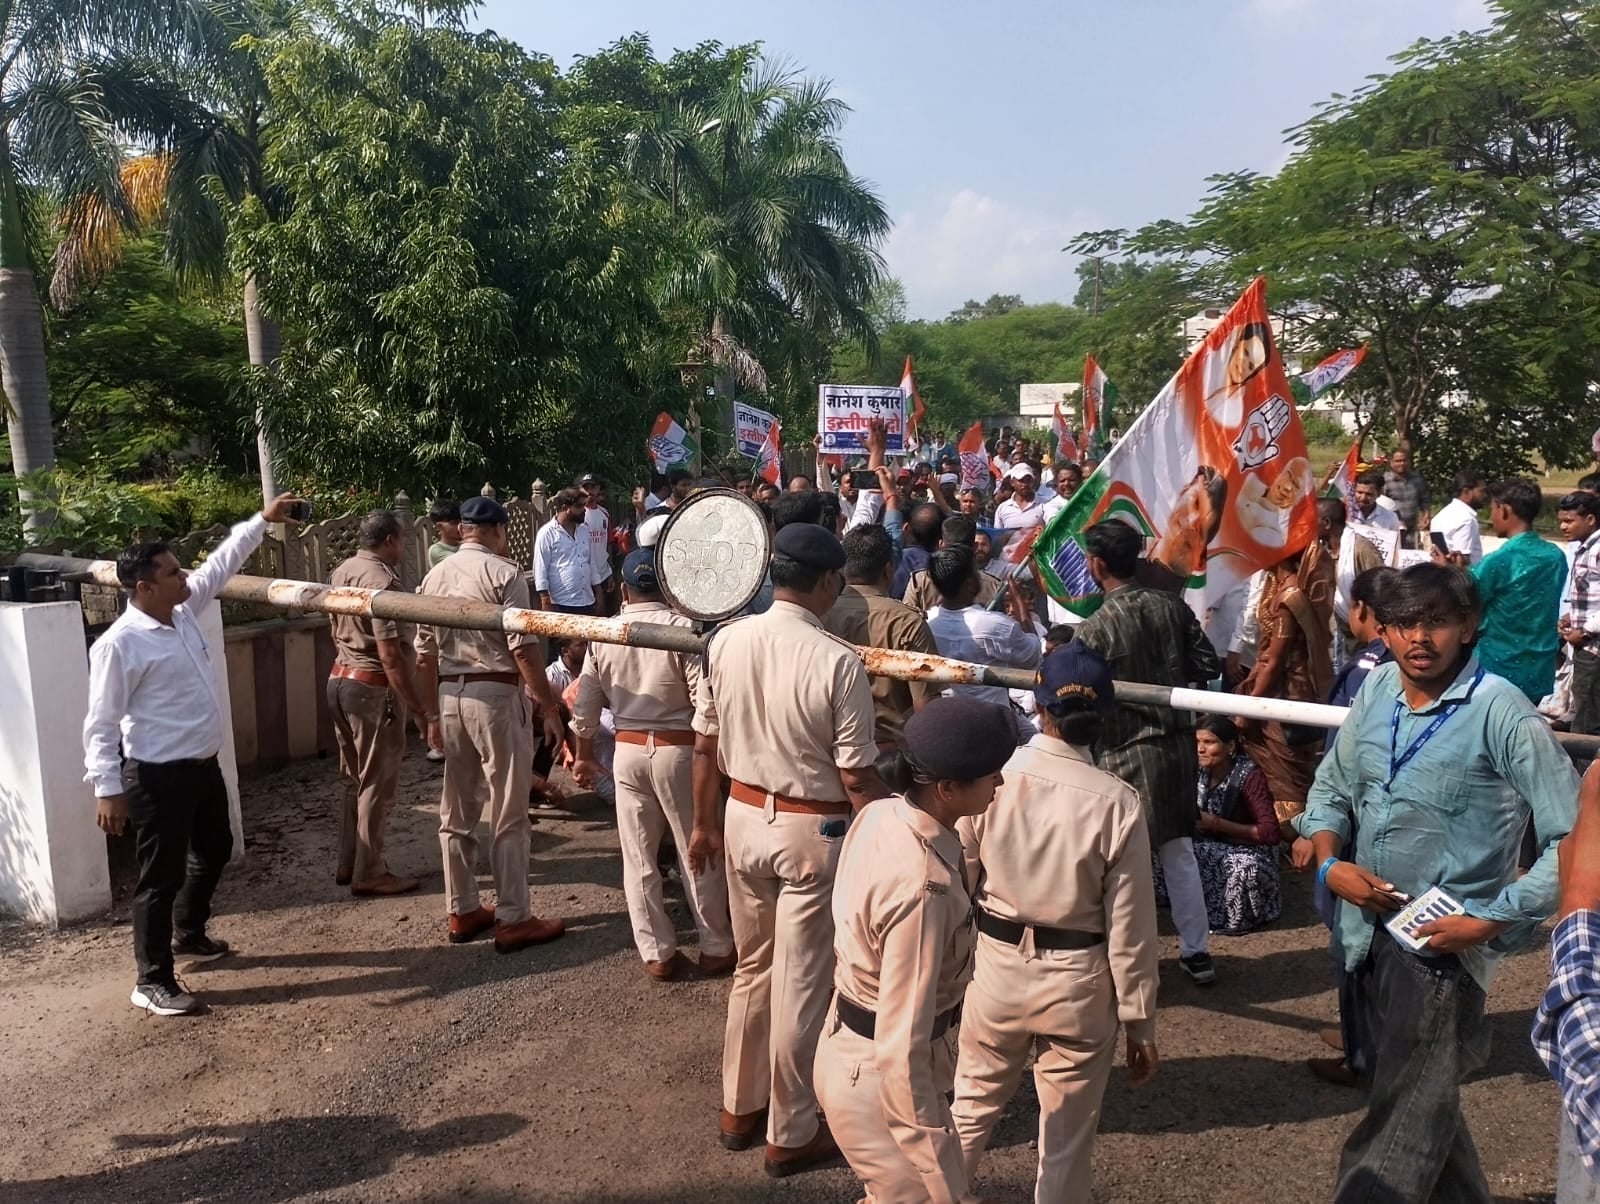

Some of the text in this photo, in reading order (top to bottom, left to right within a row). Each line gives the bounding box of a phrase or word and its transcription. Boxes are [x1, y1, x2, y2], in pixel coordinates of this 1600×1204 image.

[826, 390, 900, 414] ज्ञानेश कुमार
[826, 412, 874, 431] इस्ती
[667, 538, 758, 569] STOP
